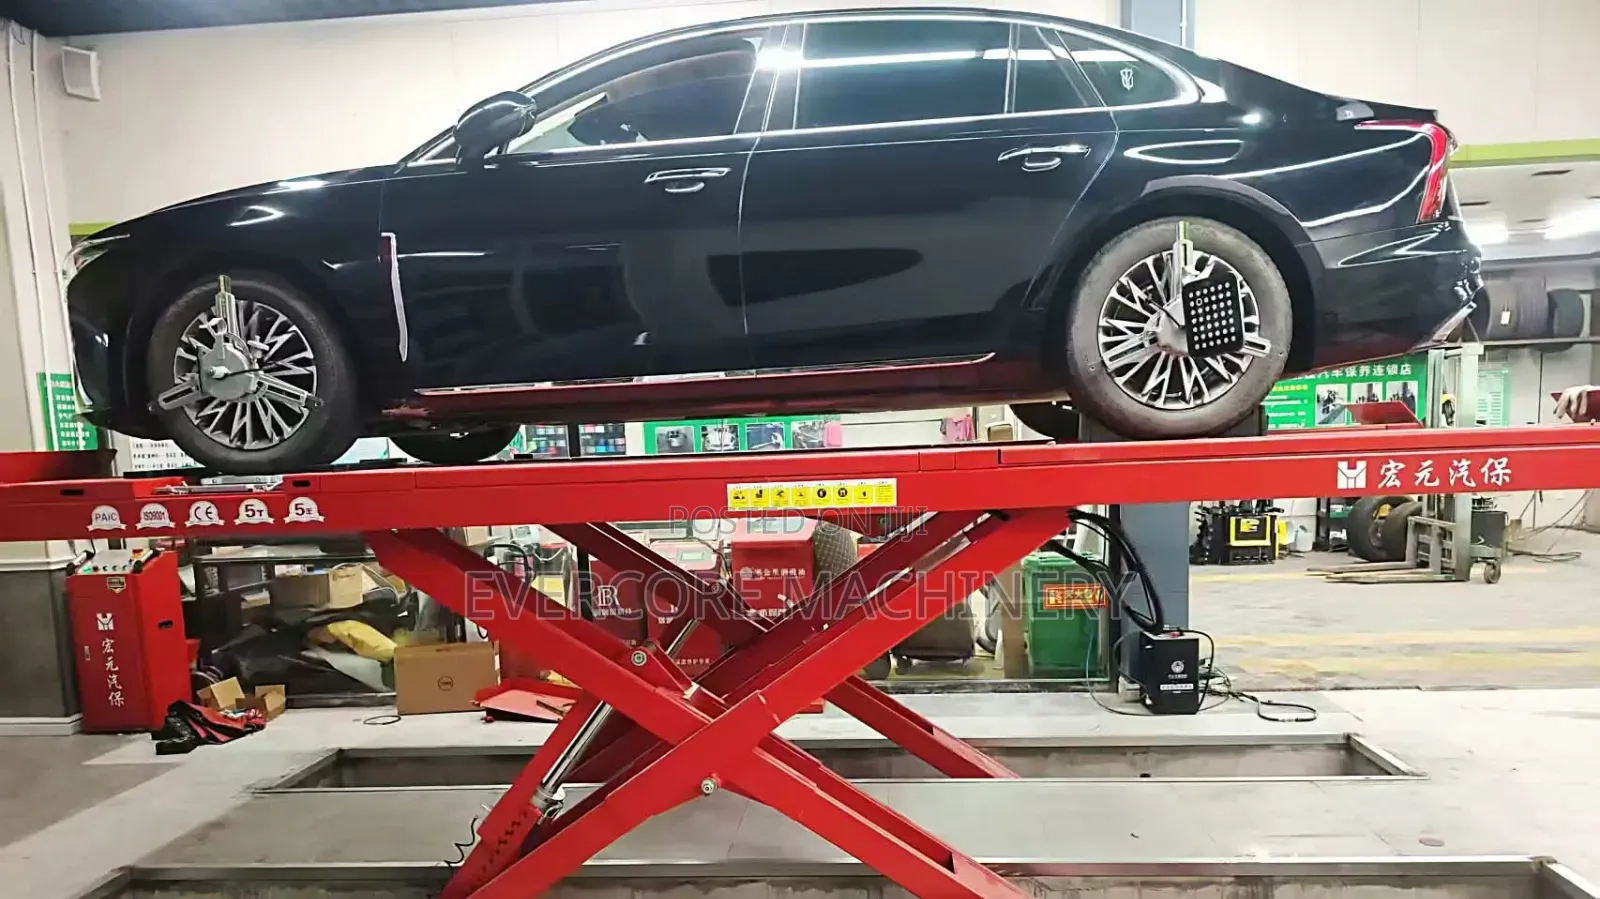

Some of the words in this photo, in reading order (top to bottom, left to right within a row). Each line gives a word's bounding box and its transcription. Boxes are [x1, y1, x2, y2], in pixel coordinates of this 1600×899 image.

[1378, 456, 1512, 489] 宏元汽保
[194, 506, 214, 521] CE
[101, 637, 125, 707] 宏元汽保
